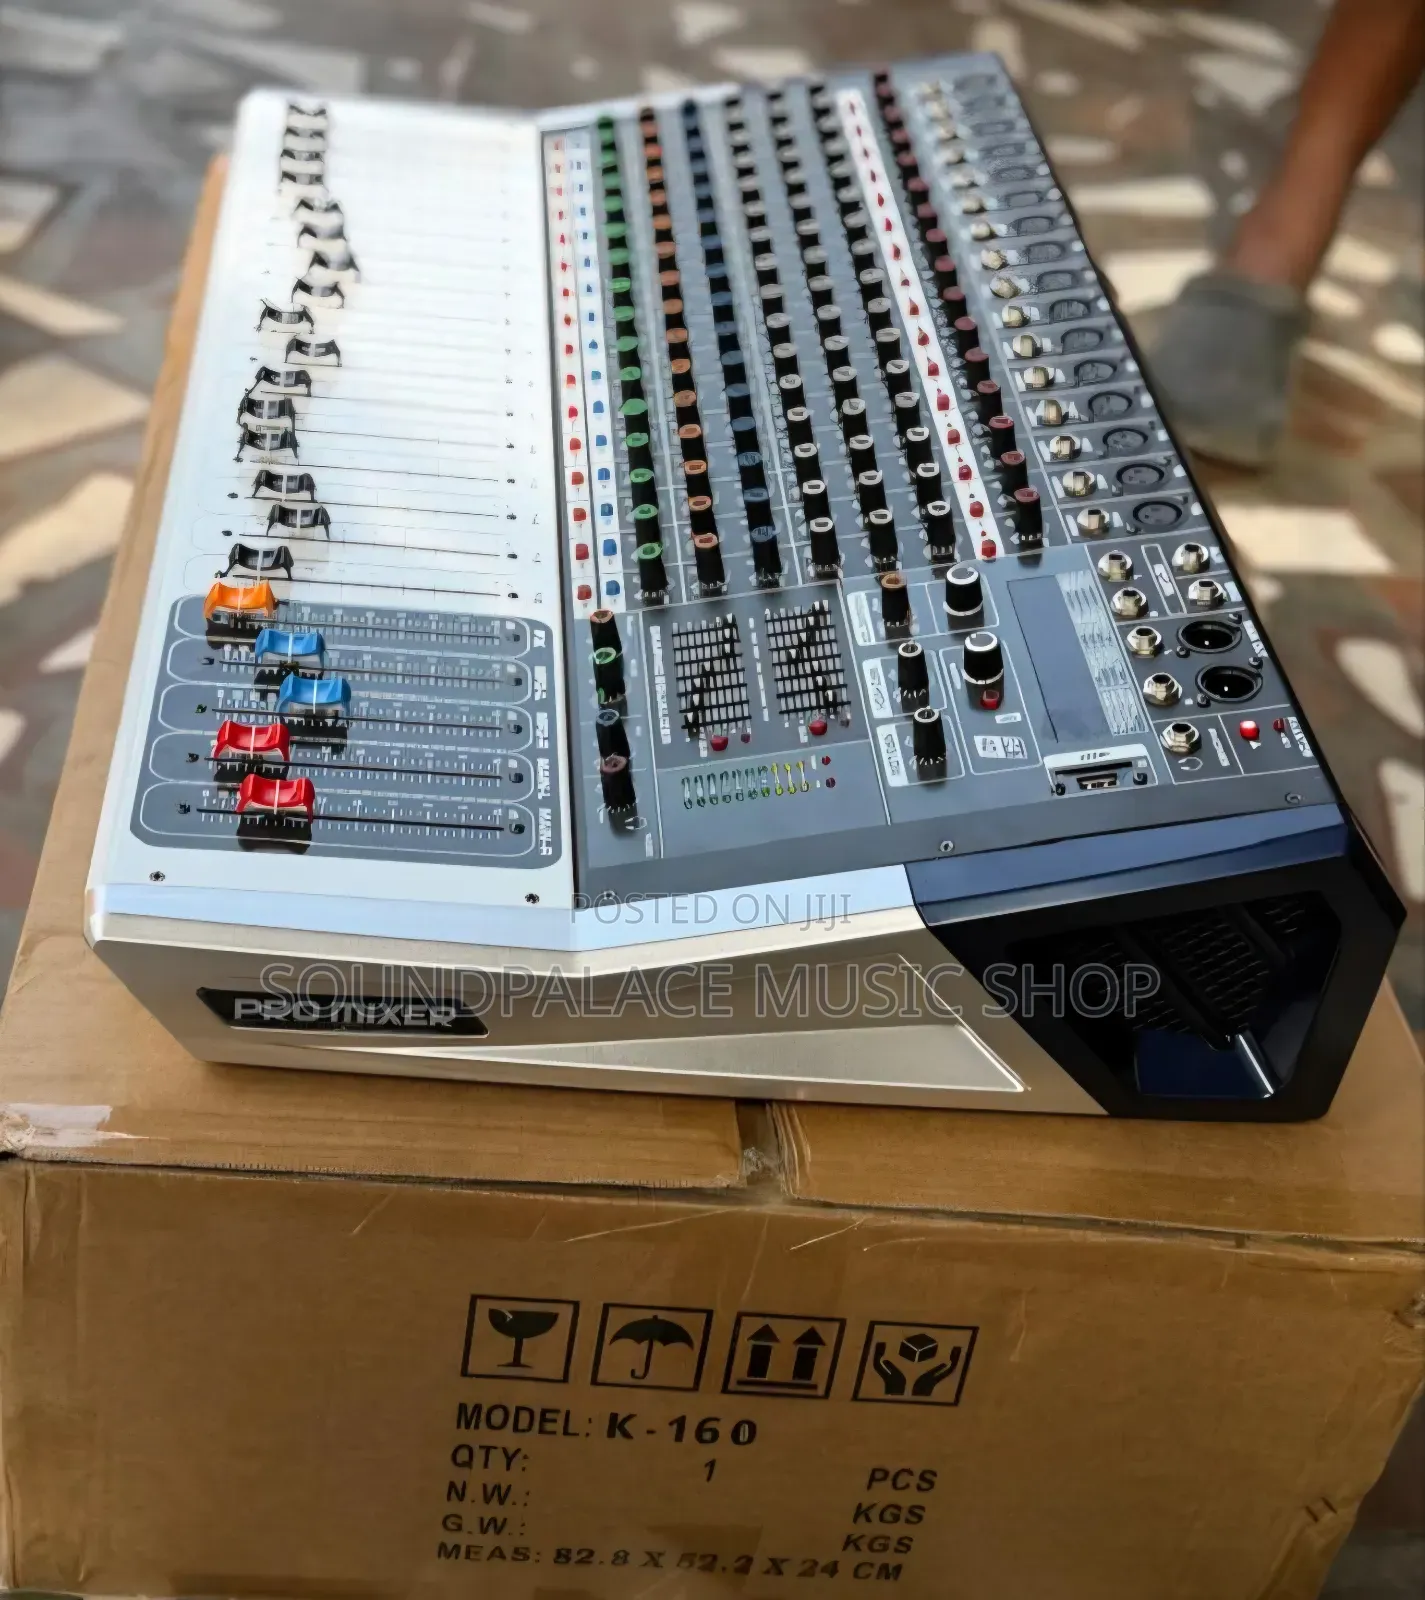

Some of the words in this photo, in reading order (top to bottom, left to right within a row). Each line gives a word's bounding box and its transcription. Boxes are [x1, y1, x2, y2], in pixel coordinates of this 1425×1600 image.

[233, 997, 320, 1023] PRO
[330, 1001, 457, 1027] MIXER
[455, 1402, 593, 1438] MODEL:
[450, 1443, 530, 1472] QTY:
[703, 1458, 717, 1483] 1
[866, 1467, 938, 1492] PCS
[446, 1480, 530, 1507] N.W.:
[851, 1501, 926, 1525] KGS
[441, 1513, 526, 1536] G.W.:
[841, 1533, 915, 1555] KGS
[436, 1541, 542, 1564] MEAS:
[552, 1547, 631, 1566] 82.8
[642, 1550, 666, 1569] X
[761, 1556, 791, 1577] X
[796, 1558, 840, 1579] 24
[852, 1561, 904, 1582] CM
